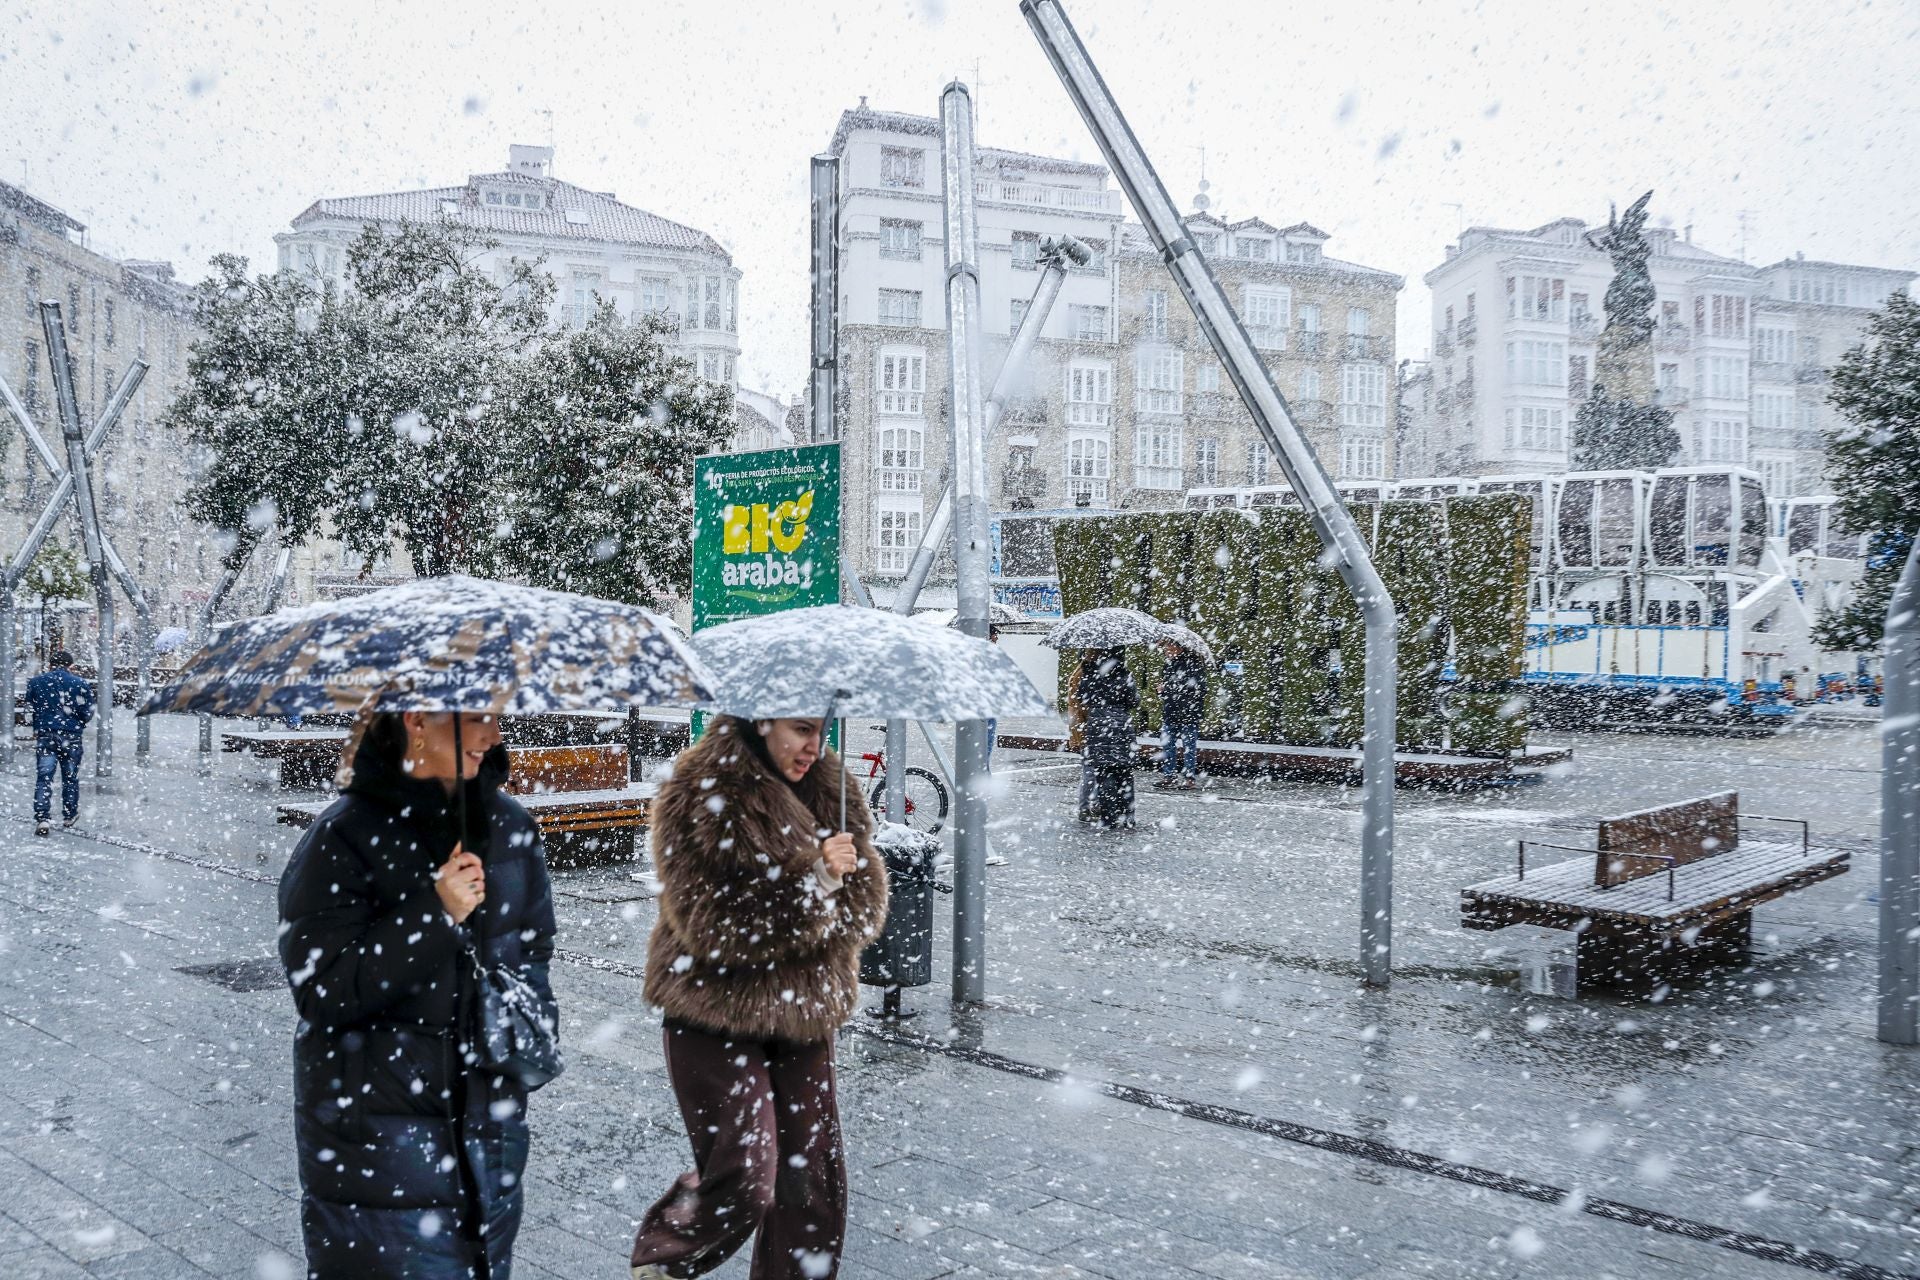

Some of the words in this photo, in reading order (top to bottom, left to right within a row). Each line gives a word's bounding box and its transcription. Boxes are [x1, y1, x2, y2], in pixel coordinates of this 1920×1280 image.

[725, 472, 740, 480] FERIA
[740, 471, 748, 479] DE
[748, 468, 780, 478] PRODUCTOS
[723, 494, 813, 554] BIO
[722, 554, 801, 586] araba
